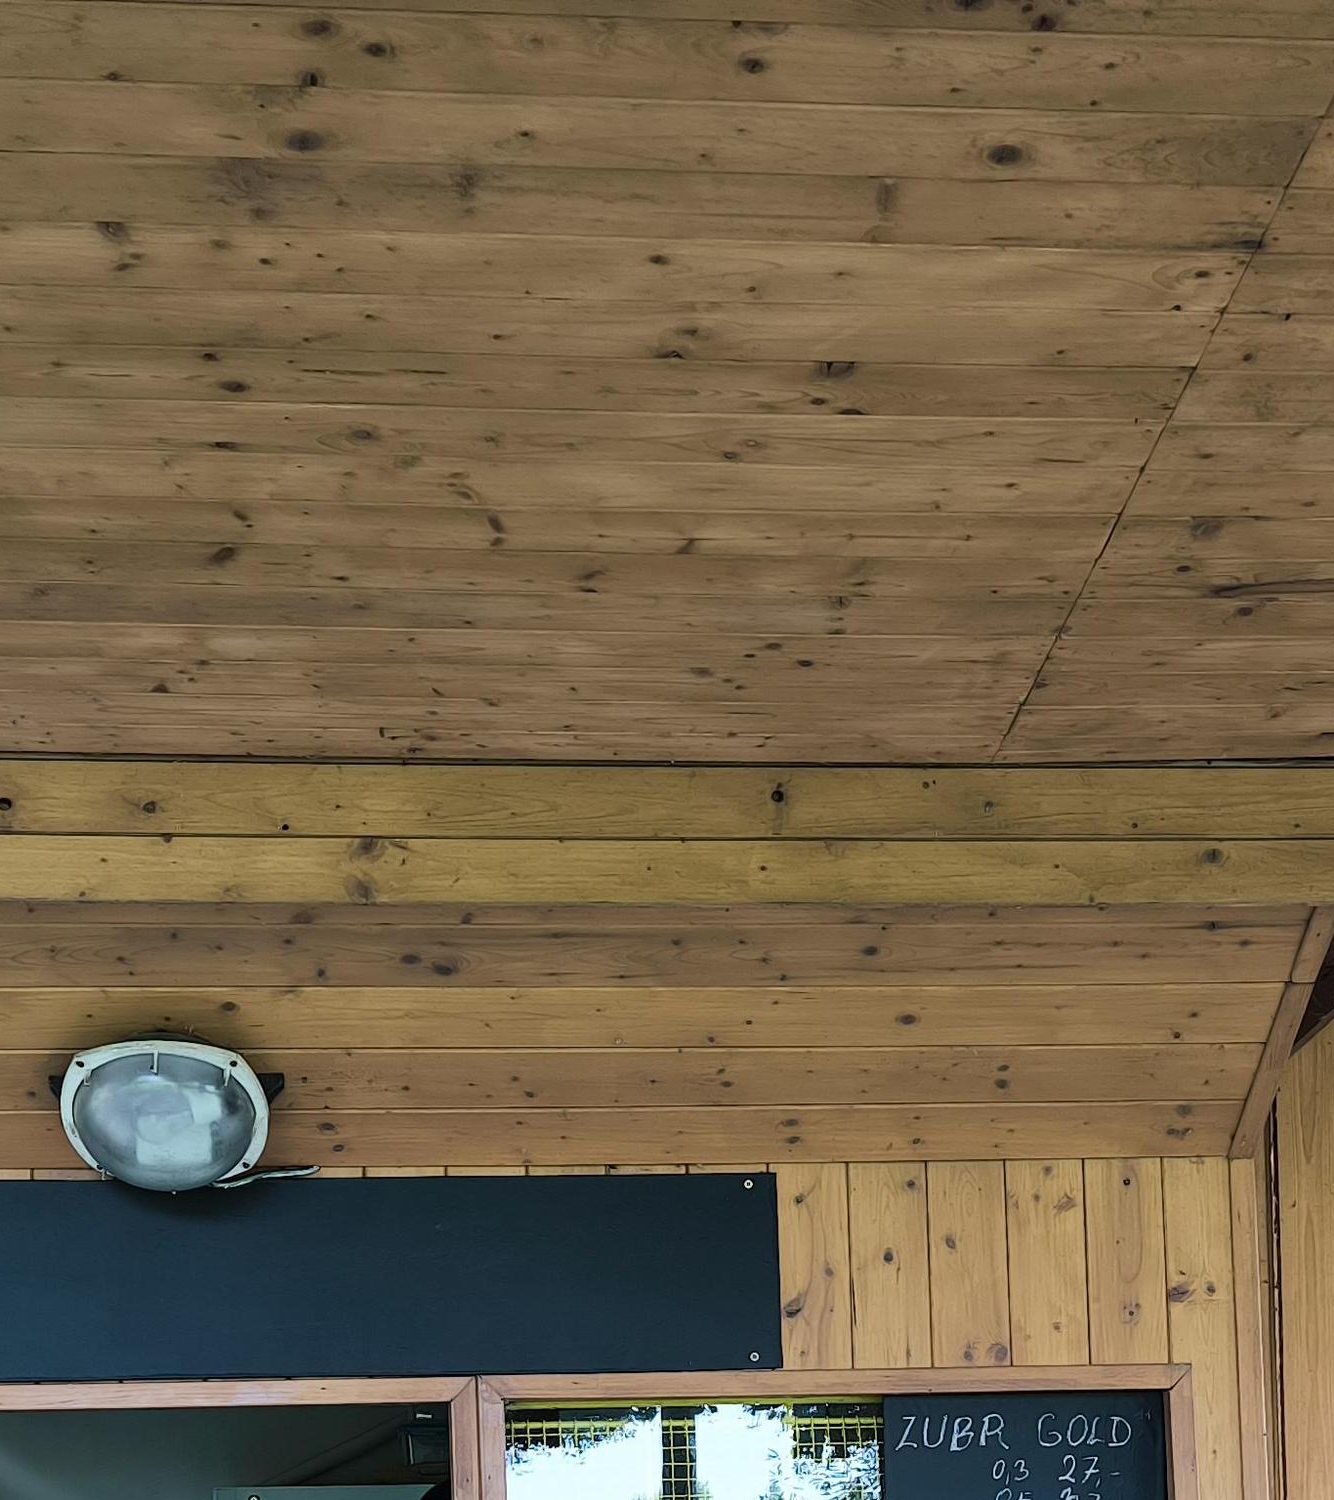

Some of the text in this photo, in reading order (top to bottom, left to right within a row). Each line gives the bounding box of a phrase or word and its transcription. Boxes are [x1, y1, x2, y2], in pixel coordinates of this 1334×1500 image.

[895, 1412, 1132, 1452] ZUBR GOLD
[992, 1458, 1030, 1486] 0,3
